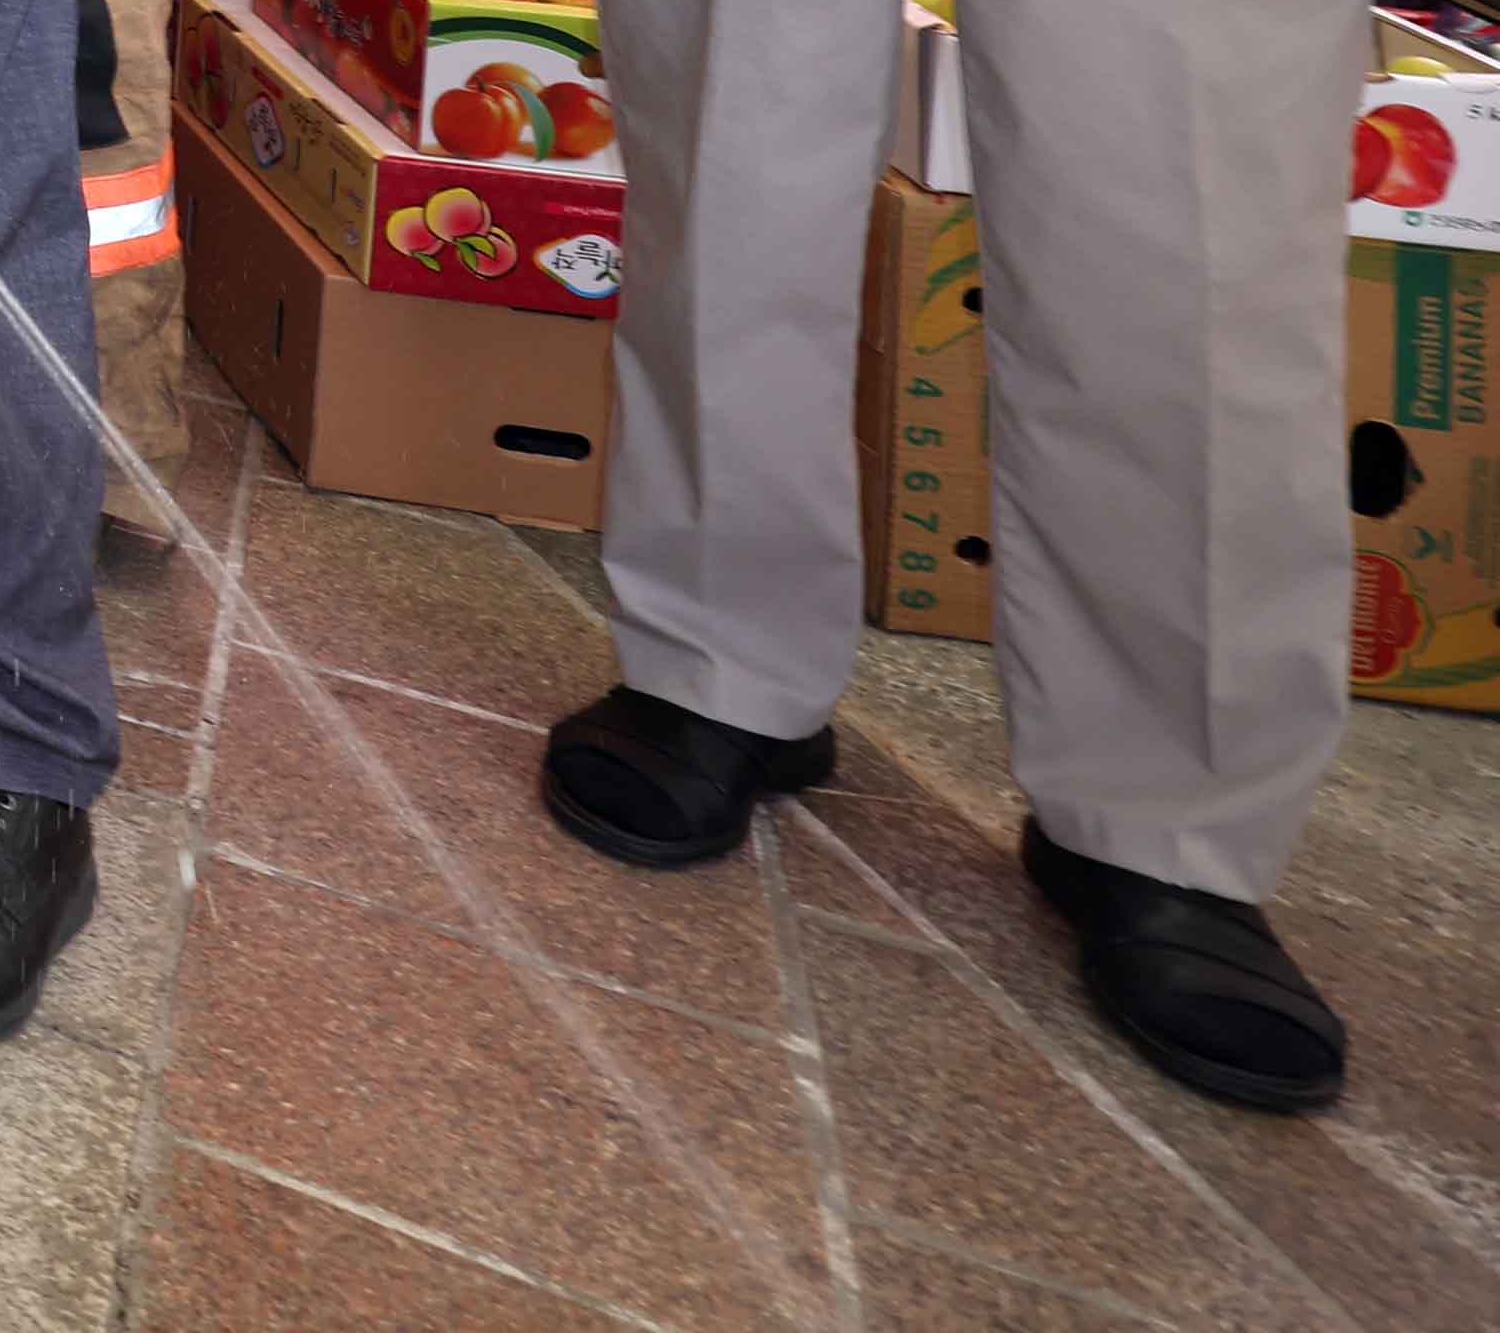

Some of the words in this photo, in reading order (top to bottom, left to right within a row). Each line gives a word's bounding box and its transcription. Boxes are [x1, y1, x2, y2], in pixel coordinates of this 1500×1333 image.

[907, 376, 944, 399] 4
[903, 425, 944, 449] 5
[903, 469, 941, 494] 6
[902, 512, 938, 534] 7
[902, 552, 938, 577] 8
[898, 587, 935, 612] 9
